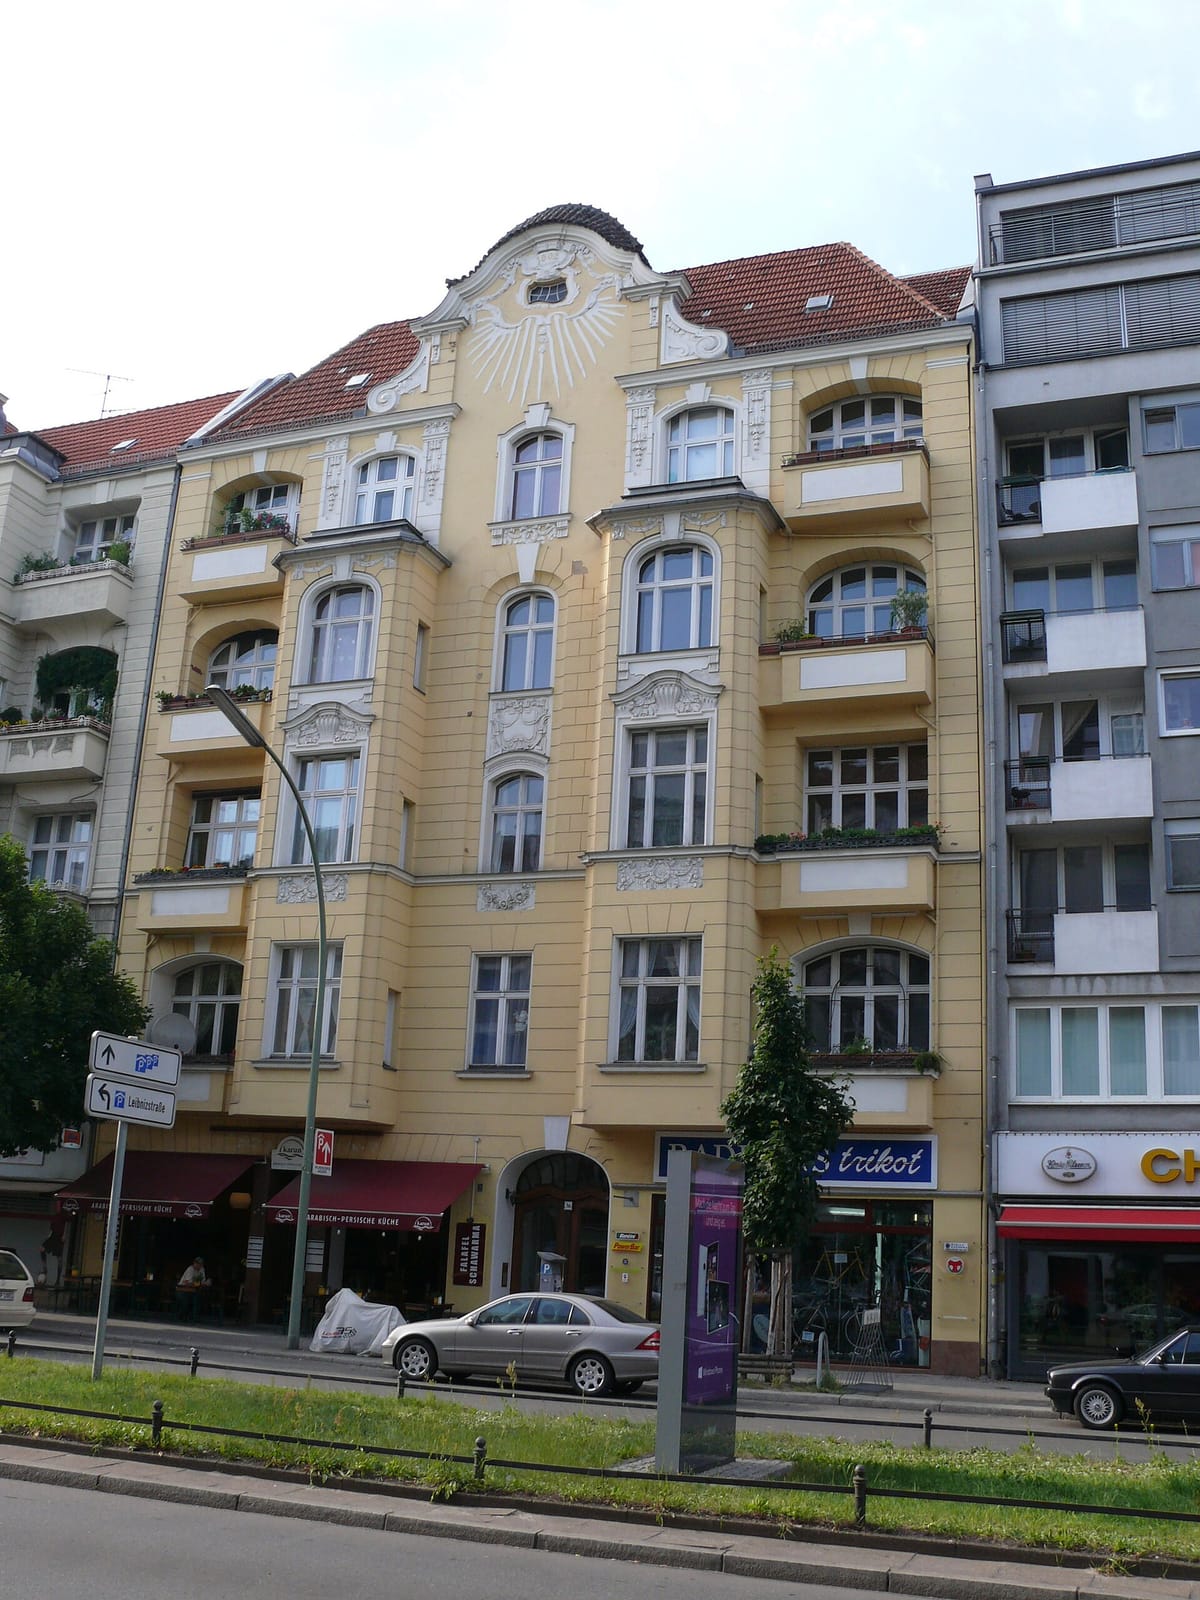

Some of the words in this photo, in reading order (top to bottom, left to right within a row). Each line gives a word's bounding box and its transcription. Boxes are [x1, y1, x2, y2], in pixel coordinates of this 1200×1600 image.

[128, 1096, 165, 1113] Leibnizstraße
[838, 1146, 924, 1175] trikot
[377, 1217, 399, 1226] KÜCHE
[460, 1236, 470, 1272] FALAFEL
